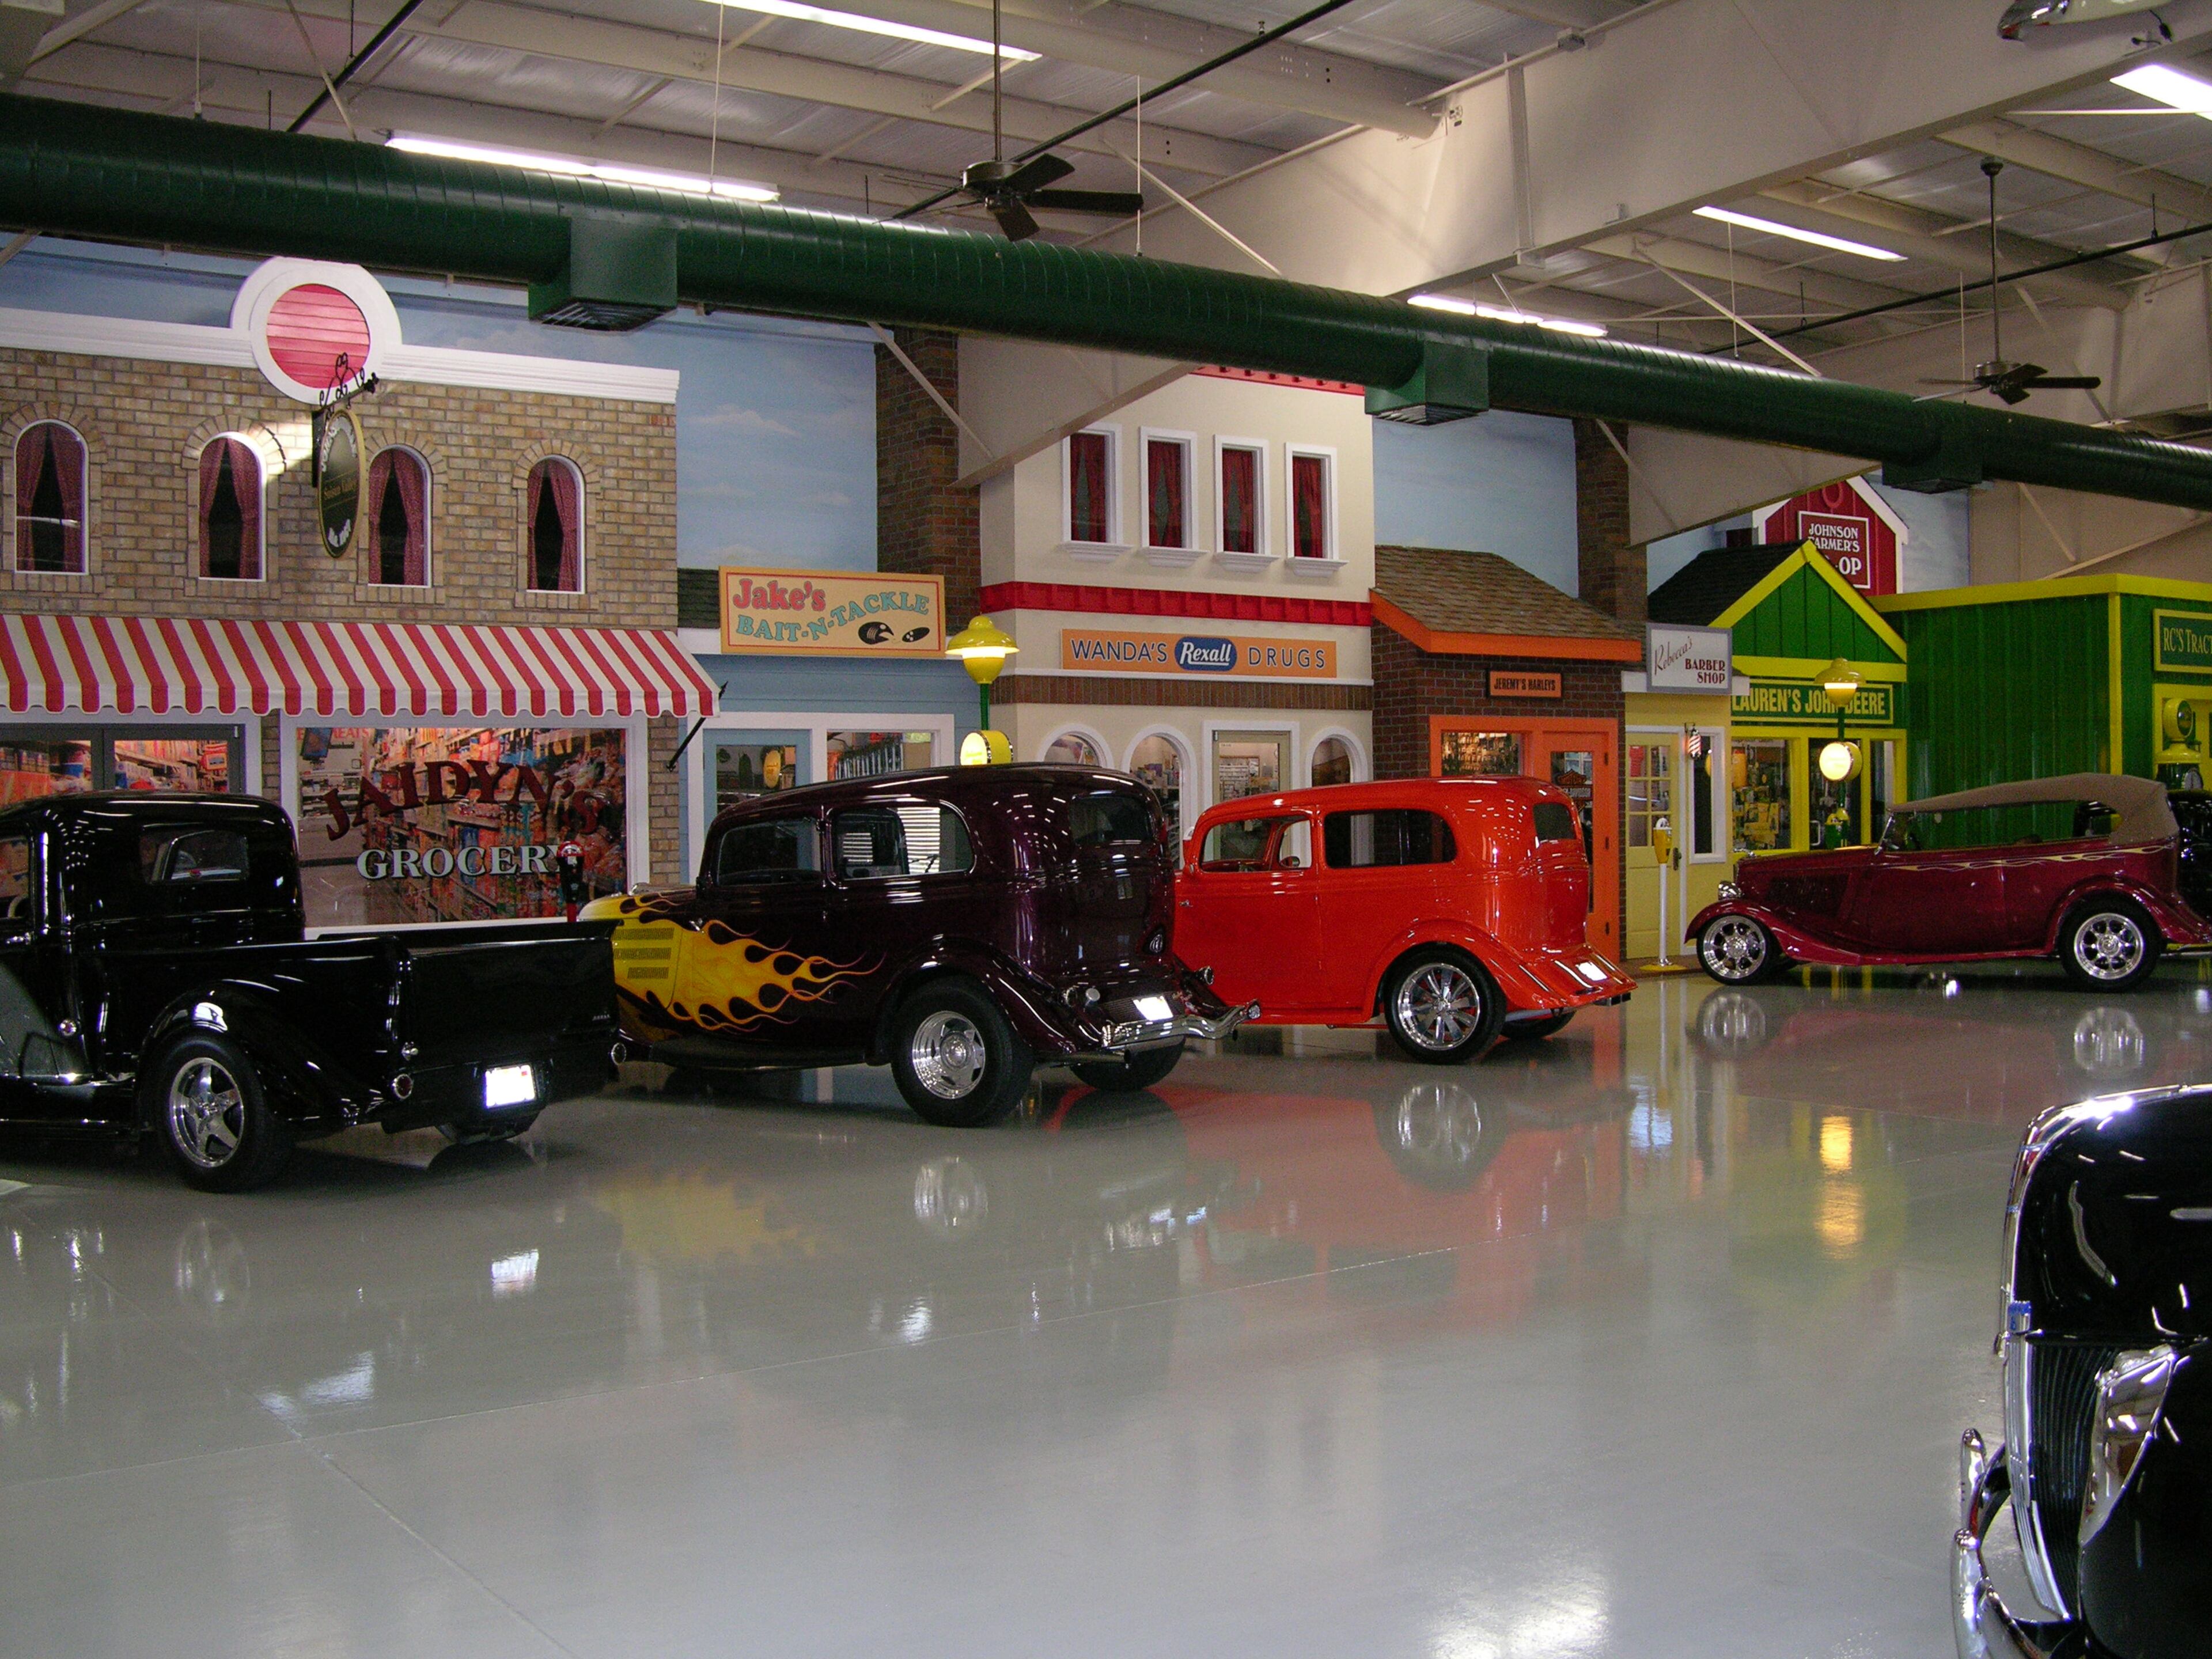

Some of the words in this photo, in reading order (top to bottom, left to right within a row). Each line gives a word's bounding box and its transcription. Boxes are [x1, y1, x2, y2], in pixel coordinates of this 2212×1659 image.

[1809, 523, 1858, 539] JOHNSON
[733, 578, 826, 611] Jake's
[736, 592, 930, 642] BAIT-N-TACKLE
[2164, 627, 2184, 652] RC'S
[1070, 639, 1168, 662] WANDA'S
[1179, 641, 1232, 665] Rexall
[1248, 647, 1325, 668] DRUGS
[1654, 636, 1692, 676] Rebecca's
[1685, 658, 1725, 671] BARBER
[1697, 672, 1725, 684] SHOP
[1732, 688, 1801, 713] LAUREN'S
[319, 759, 605, 841] JAIDYN'S
